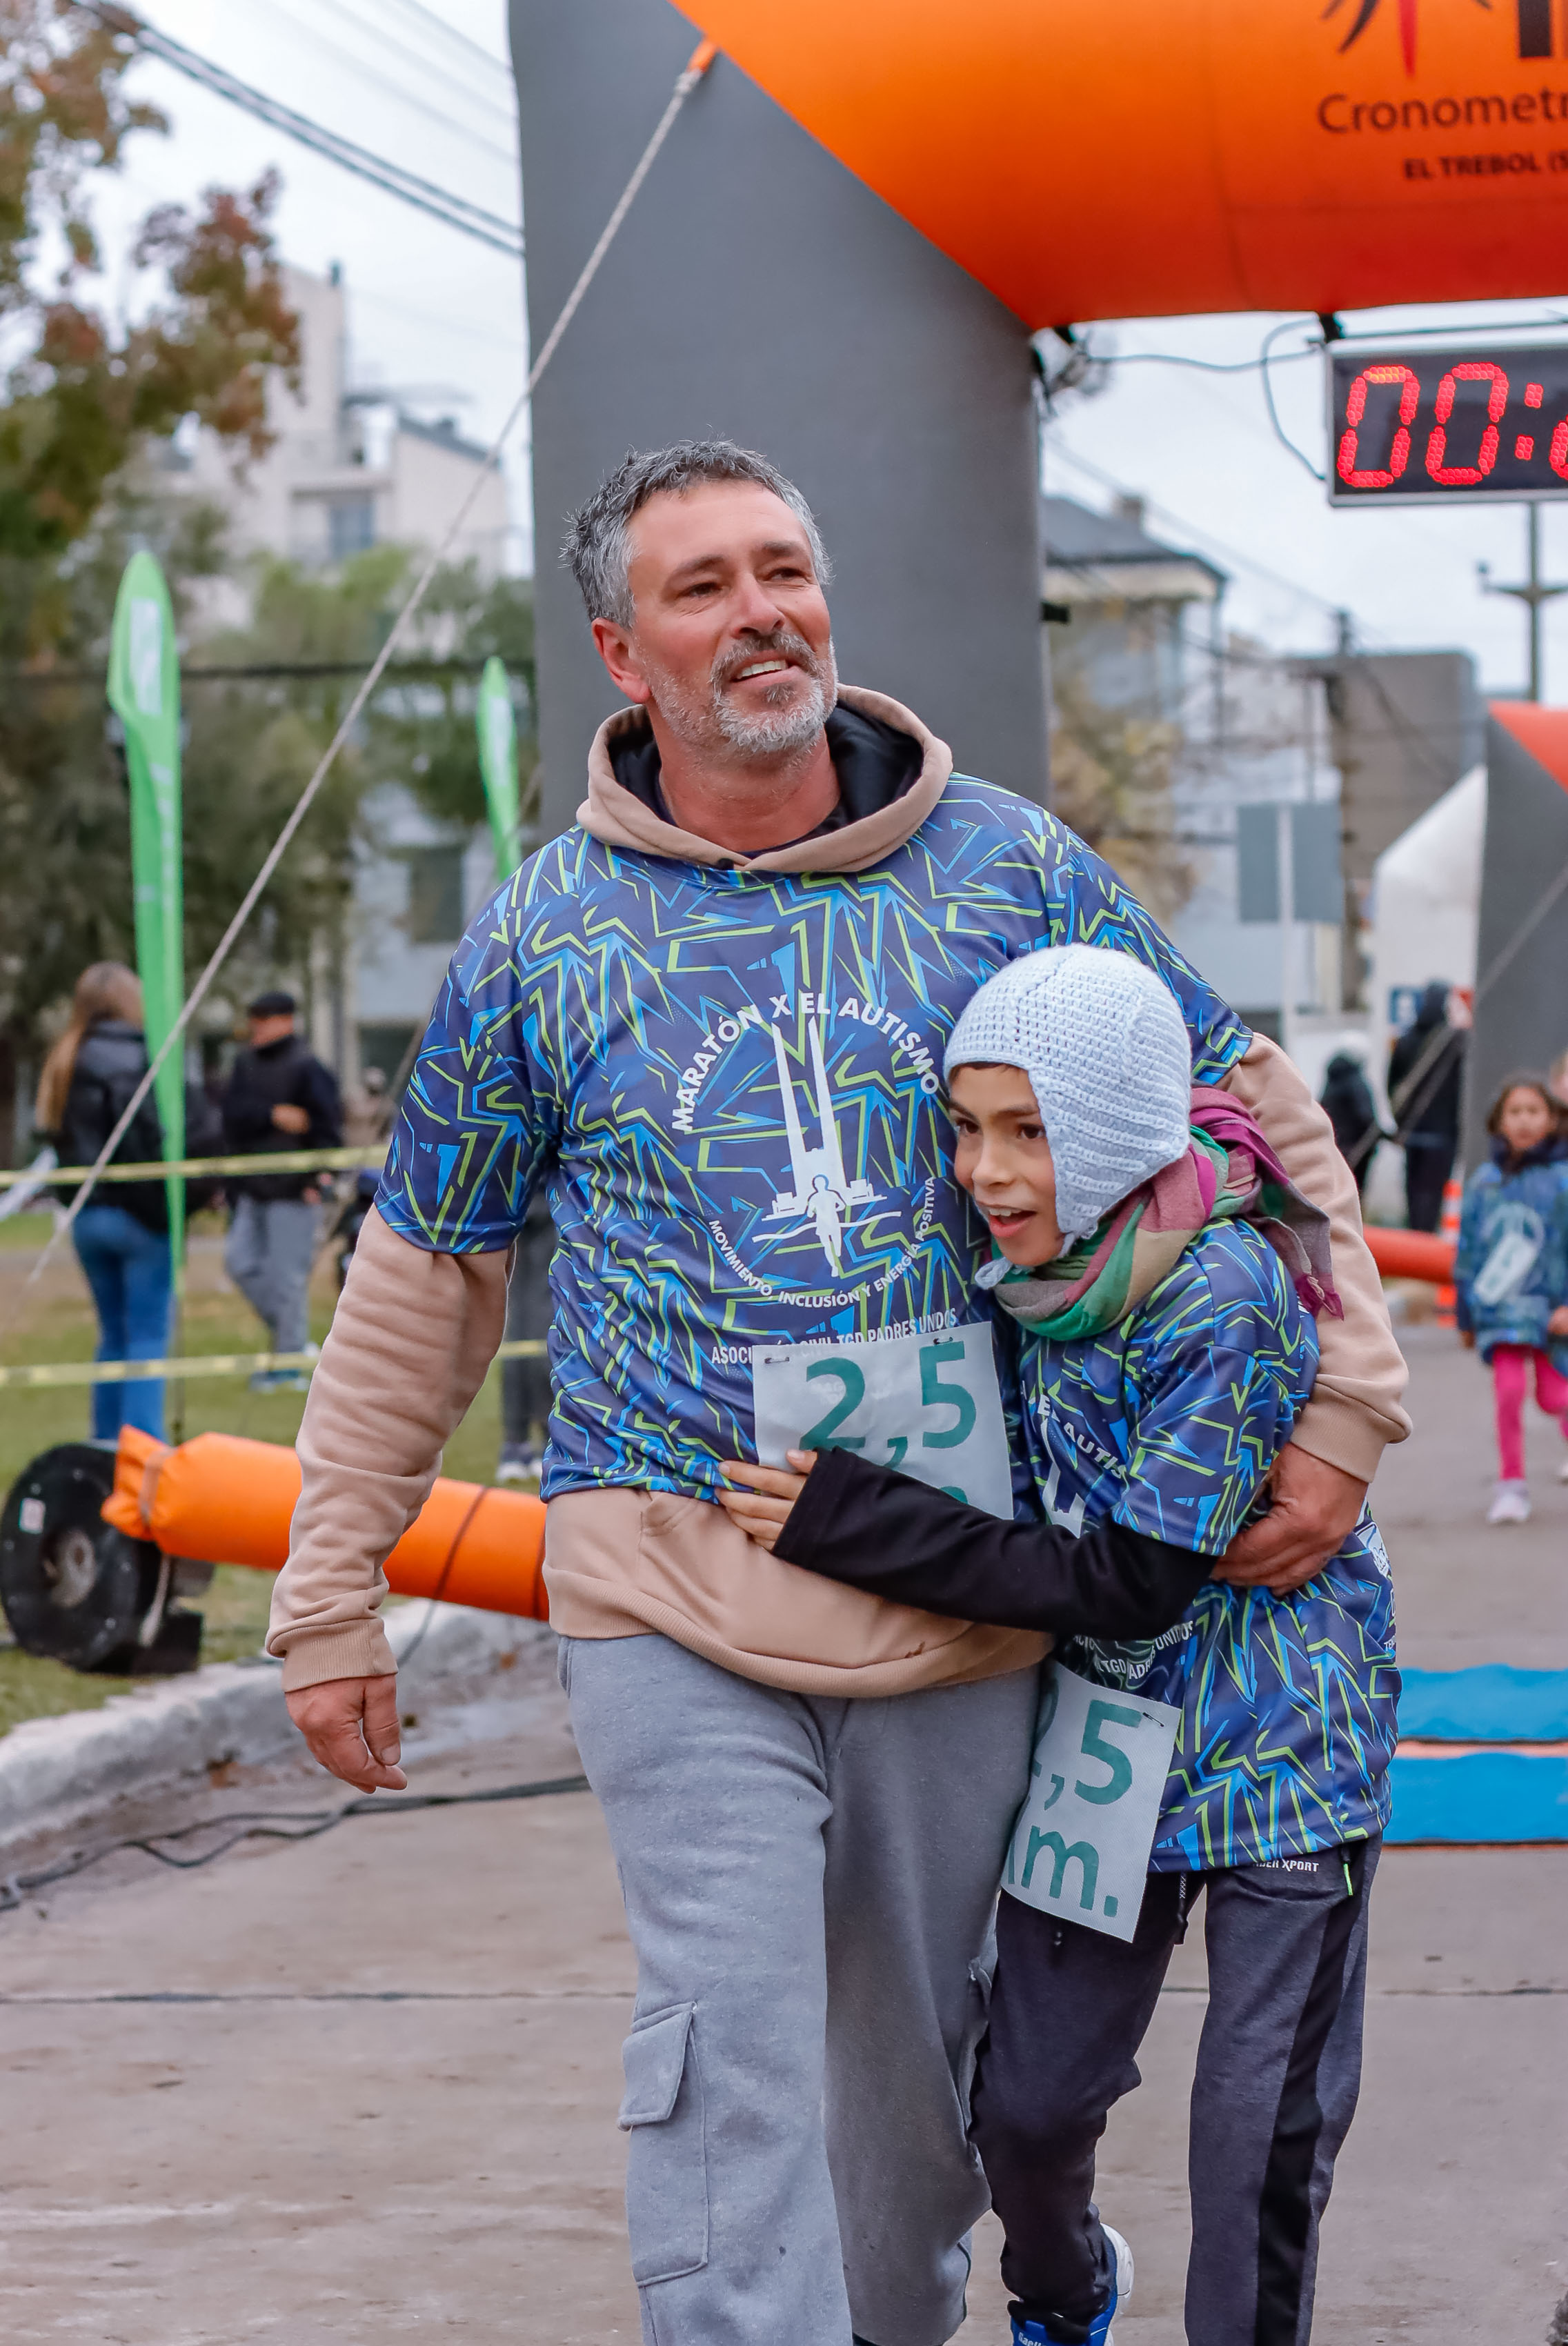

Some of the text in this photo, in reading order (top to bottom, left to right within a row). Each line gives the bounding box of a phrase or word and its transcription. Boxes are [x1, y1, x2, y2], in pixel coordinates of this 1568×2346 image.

[672, 992, 939, 1131] MARATÓN X EL AUTISMO
[708, 1220, 773, 1300] MOVIMIENTO,
[778, 1290, 860, 1308] INCLUSIÓN
[862, 1285, 871, 1297] Y
[915, 1177, 936, 1241] POSITIVA
[867, 1318, 917, 1342] PADRES
[799, 1341, 977, 1471] 2,5
[1063, 1422, 1127, 1479] AUTIS
[1282, 1858, 1319, 1872] XPORT
